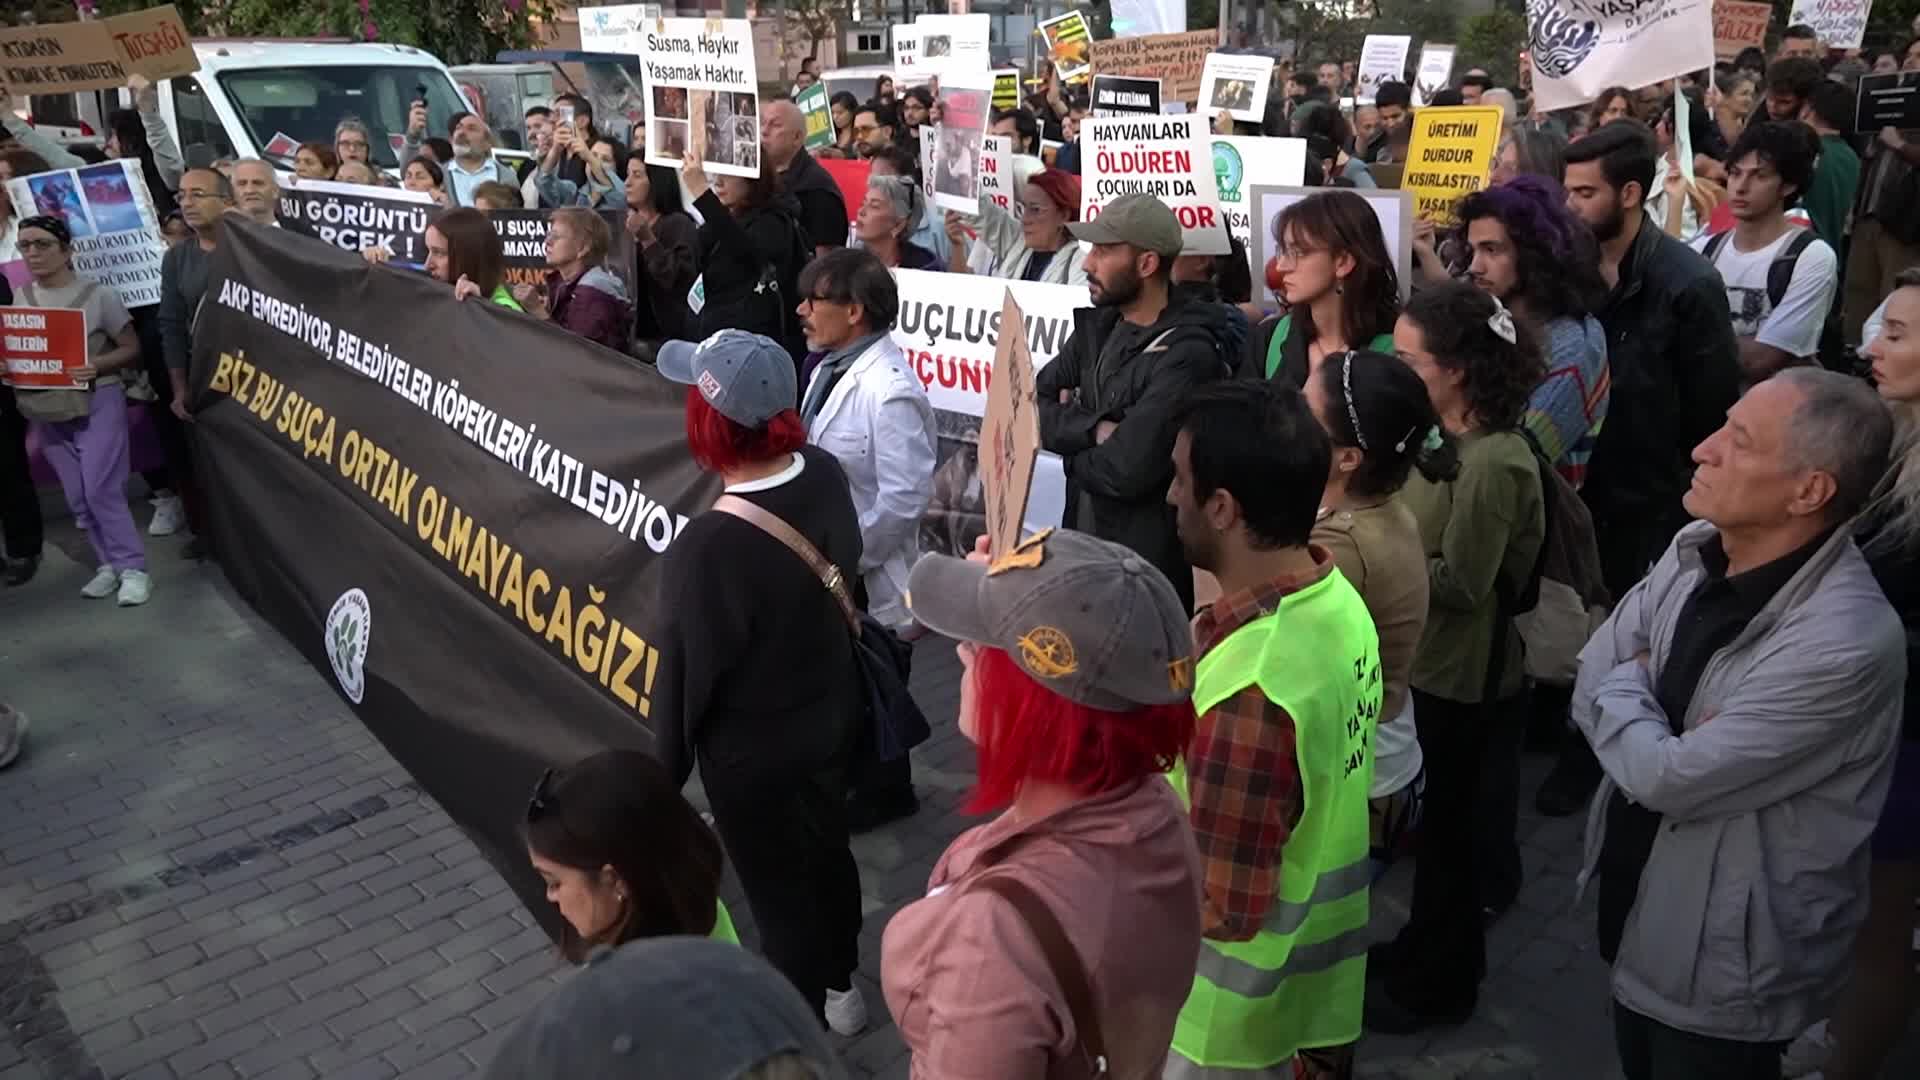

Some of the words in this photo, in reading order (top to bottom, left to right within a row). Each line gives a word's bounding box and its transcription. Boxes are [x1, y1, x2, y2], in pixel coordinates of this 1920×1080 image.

[647, 33, 694, 56] Susma,
[698, 35, 739, 58] Haykır
[647, 62, 701, 84] Yaşamak
[705, 64, 747, 84] Haktır.
[1094, 121, 1191, 142] HAYVANLARI
[1096, 144, 1192, 174] ÖLDÜREN
[1423, 148, 1473, 163] DURDUR
[1097, 179, 1169, 200] ÇOCUKLARI
[1173, 180, 1197, 196] DA
[280, 198, 300, 219] BU
[306, 197, 427, 234] GÖRÜNTÜ
[507, 220, 546, 240] SUÇA
[72, 231, 154, 254] ÖLDÜRMEYİN
[78, 249, 159, 271] ÖLDÜRMEYİN
[99, 267, 162, 287] DÜRMEYİN
[121, 287, 161, 303] RMEYİ
[218, 278, 250, 312] AKP
[252, 290, 334, 361] EMREDİYOR,
[336, 329, 434, 412] BELEDİYELER
[431, 379, 537, 472] KÖPEKLERİ
[208, 350, 256, 405] BİZ
[248, 372, 285, 422] BU
[276, 391, 337, 465] SUÇA
[339, 430, 419, 524] ORTAK
[417, 486, 660, 719] OLMAYACAĞIZ!
